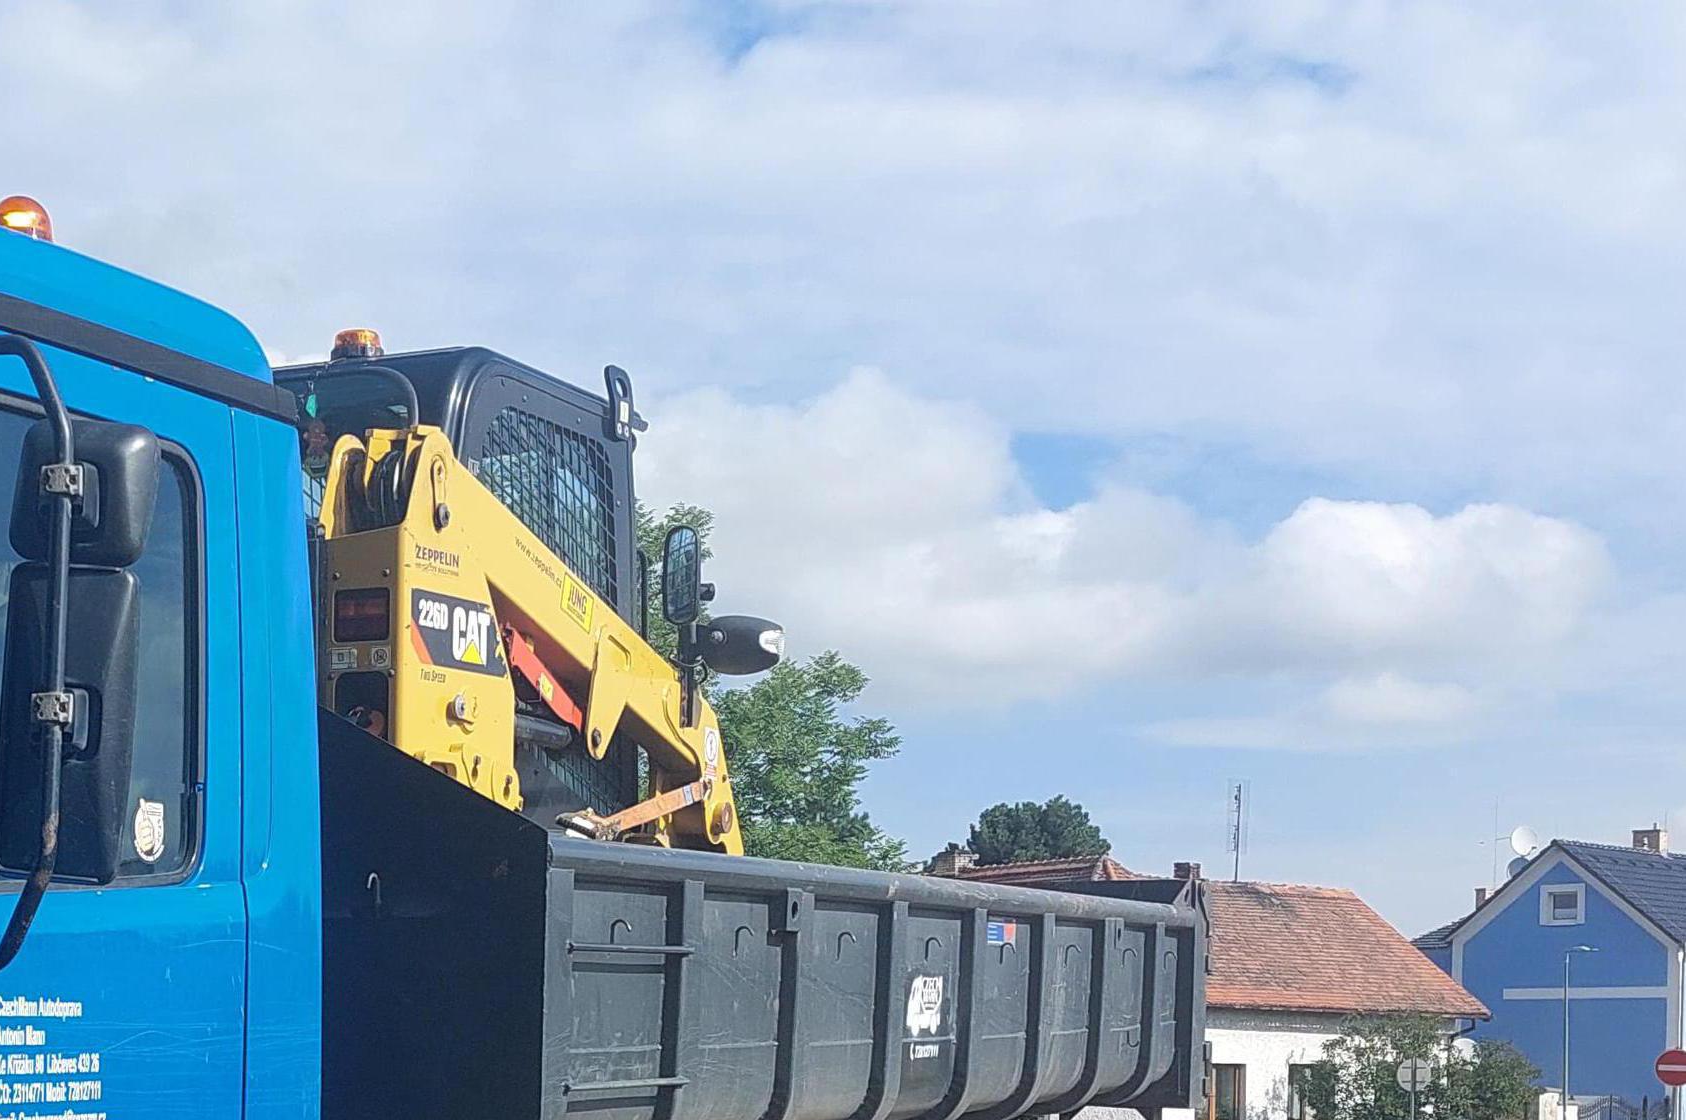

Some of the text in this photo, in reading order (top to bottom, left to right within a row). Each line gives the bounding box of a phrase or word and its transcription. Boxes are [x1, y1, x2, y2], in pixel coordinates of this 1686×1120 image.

[415, 543, 460, 568] ZEPPELIN
[418, 598, 449, 631] 226D
[452, 606, 491, 667] CAT
[38, 996, 83, 1022] Autodoprava
[25, 1025, 46, 1046] Mann
